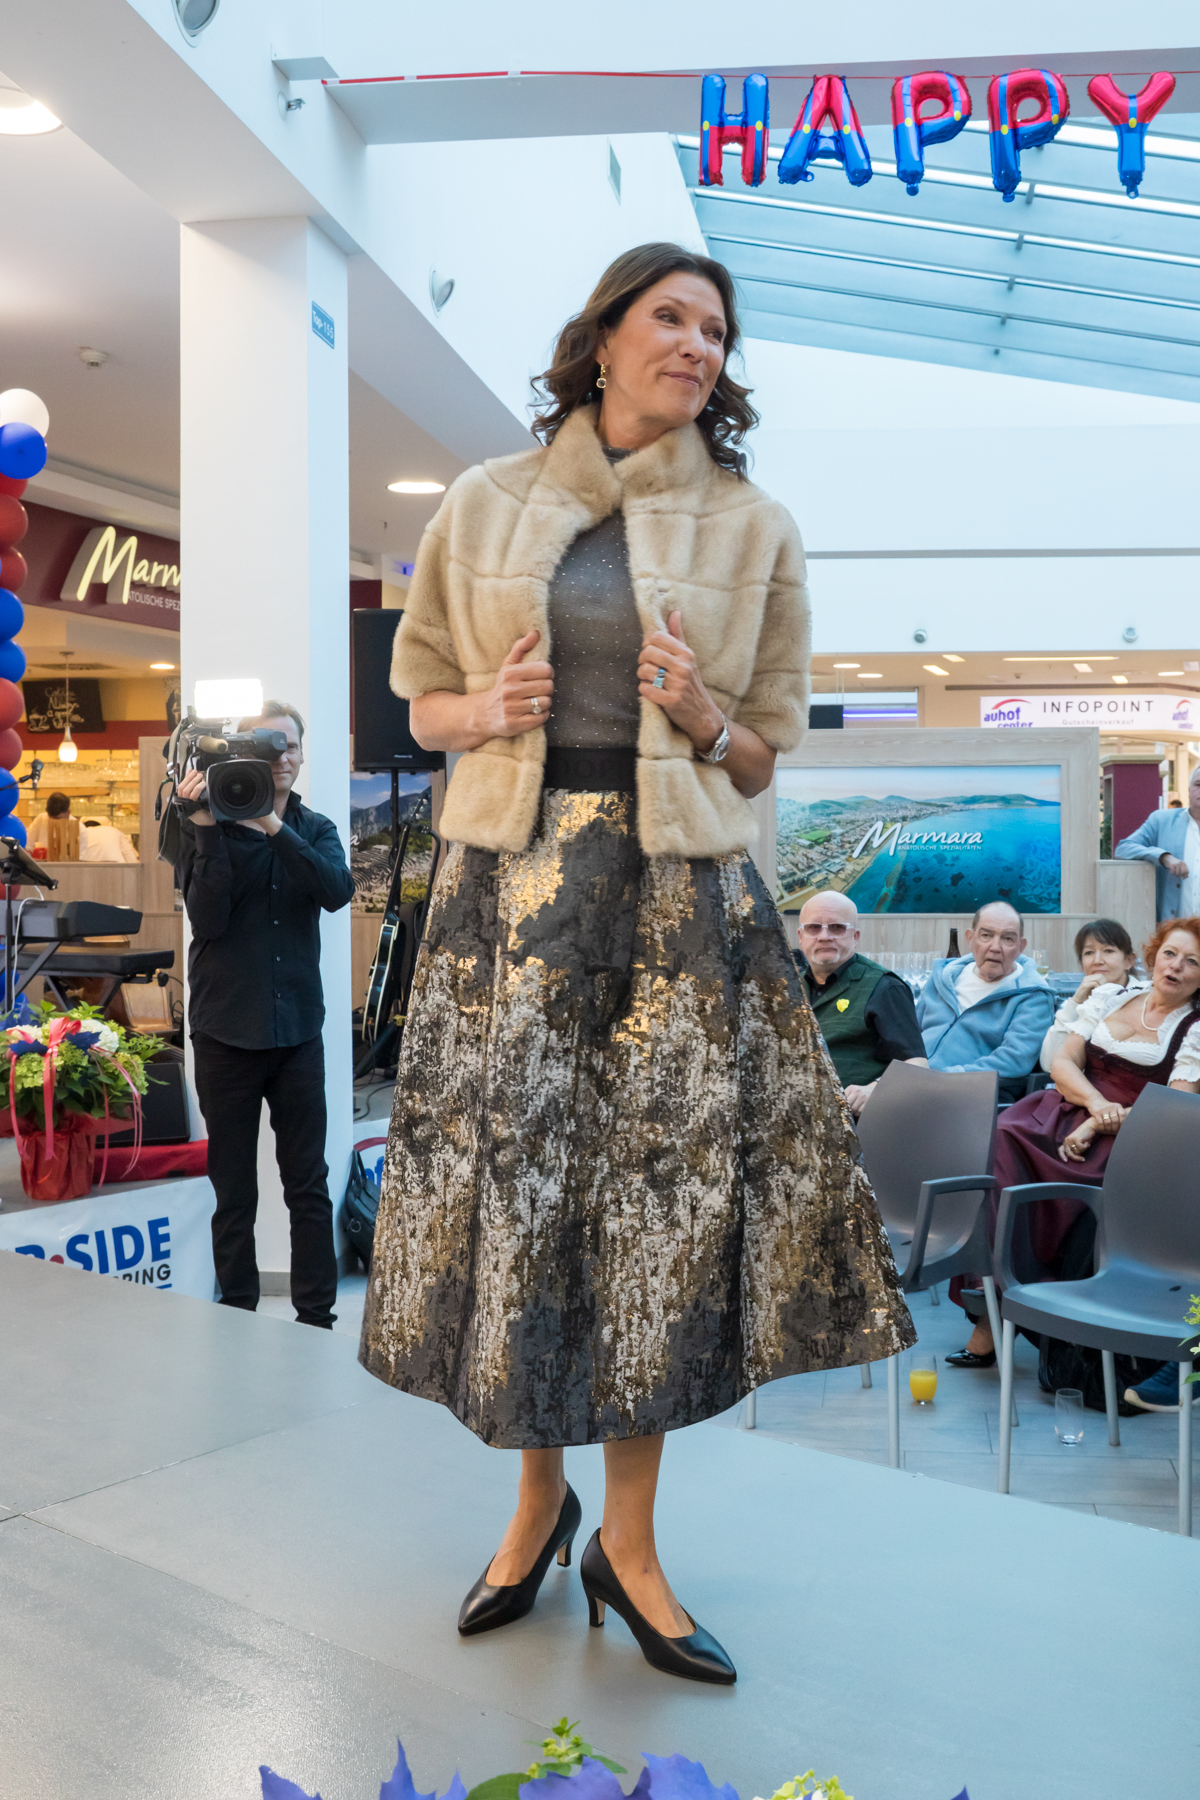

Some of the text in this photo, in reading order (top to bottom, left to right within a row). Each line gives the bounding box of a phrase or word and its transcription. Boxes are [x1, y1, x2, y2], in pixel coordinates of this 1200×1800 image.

[698, 68, 1176, 202] HAPPY
[984, 707, 1021, 722] auhof
[1043, 700, 1154, 713] INFOPOINT
[852, 820, 983, 859] Marmara
